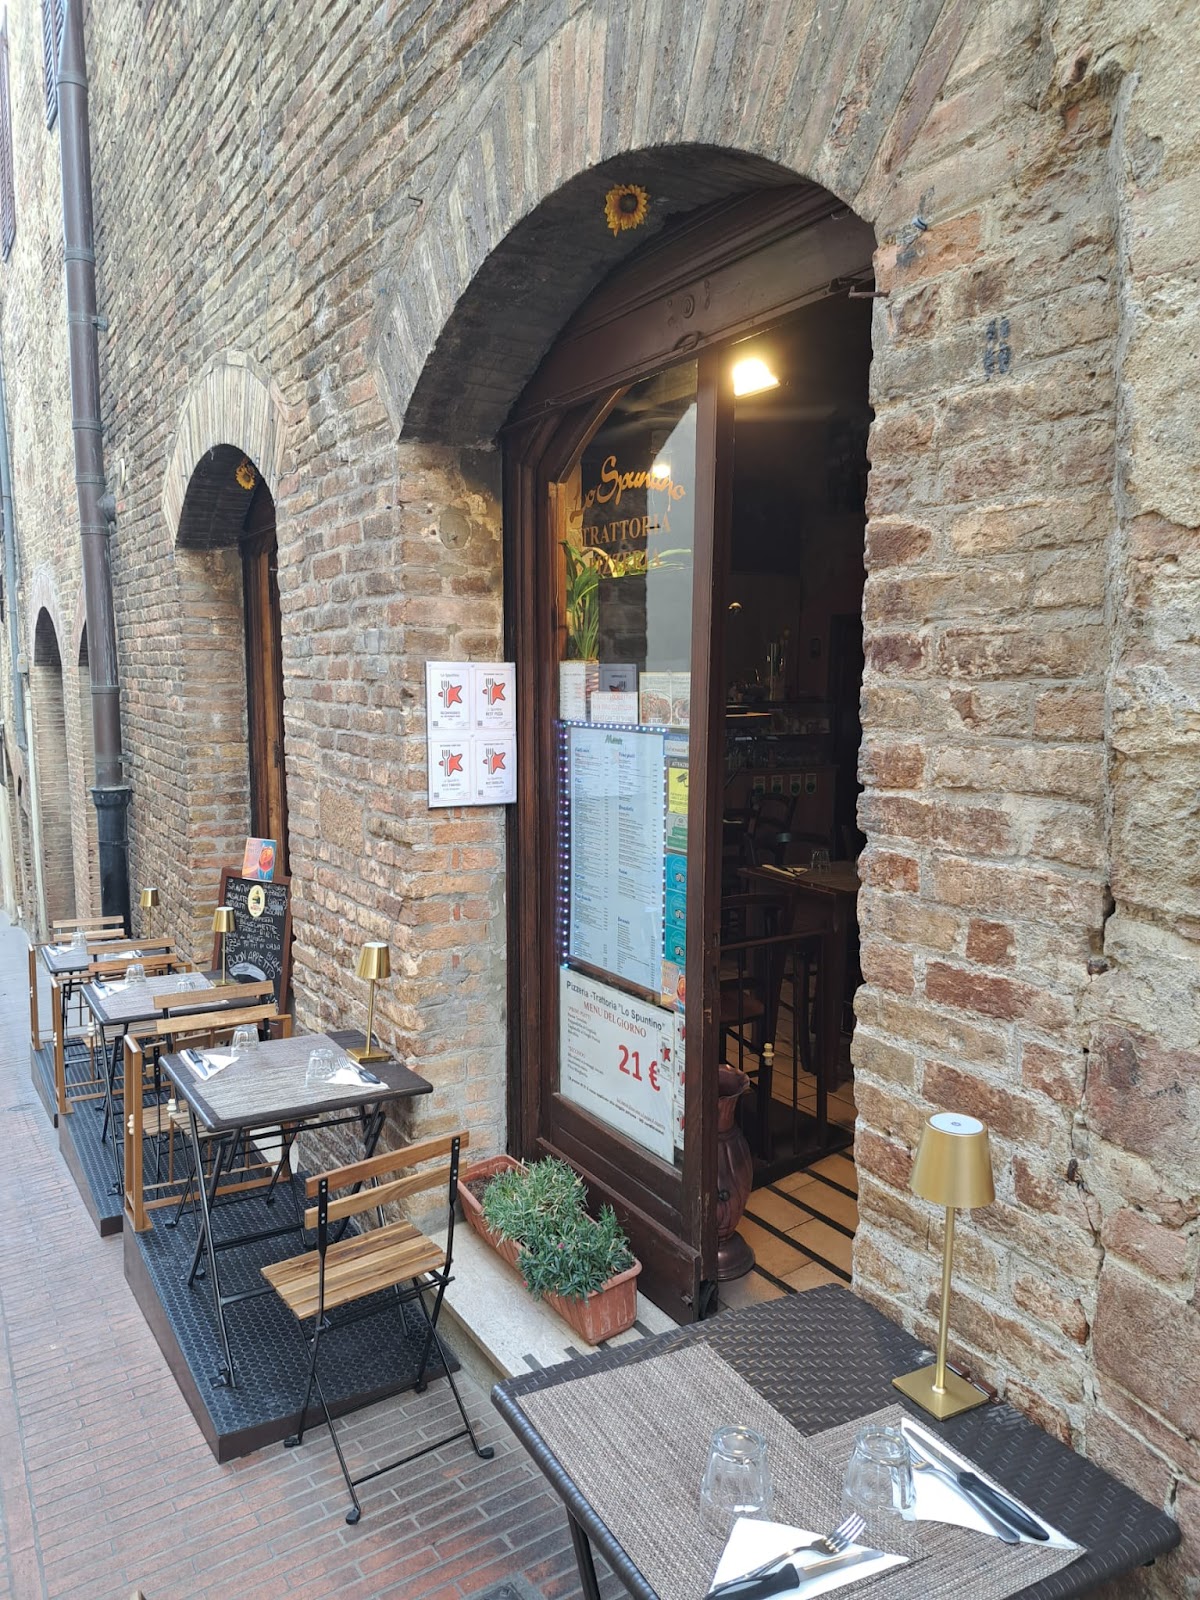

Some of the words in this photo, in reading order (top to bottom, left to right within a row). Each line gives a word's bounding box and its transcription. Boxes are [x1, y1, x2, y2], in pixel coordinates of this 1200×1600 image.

[581, 511, 671, 547] TRATTORIA
[227, 950, 247, 968] BUON
[566, 980, 589, 998] Pizzeria
[583, 1001, 603, 1017] MENU
[603, 1010, 616, 1024] DEL
[616, 1017, 647, 1038] GIORNO
[618, 1044, 643, 1082] 21
[648, 1060, 661, 1092] €
